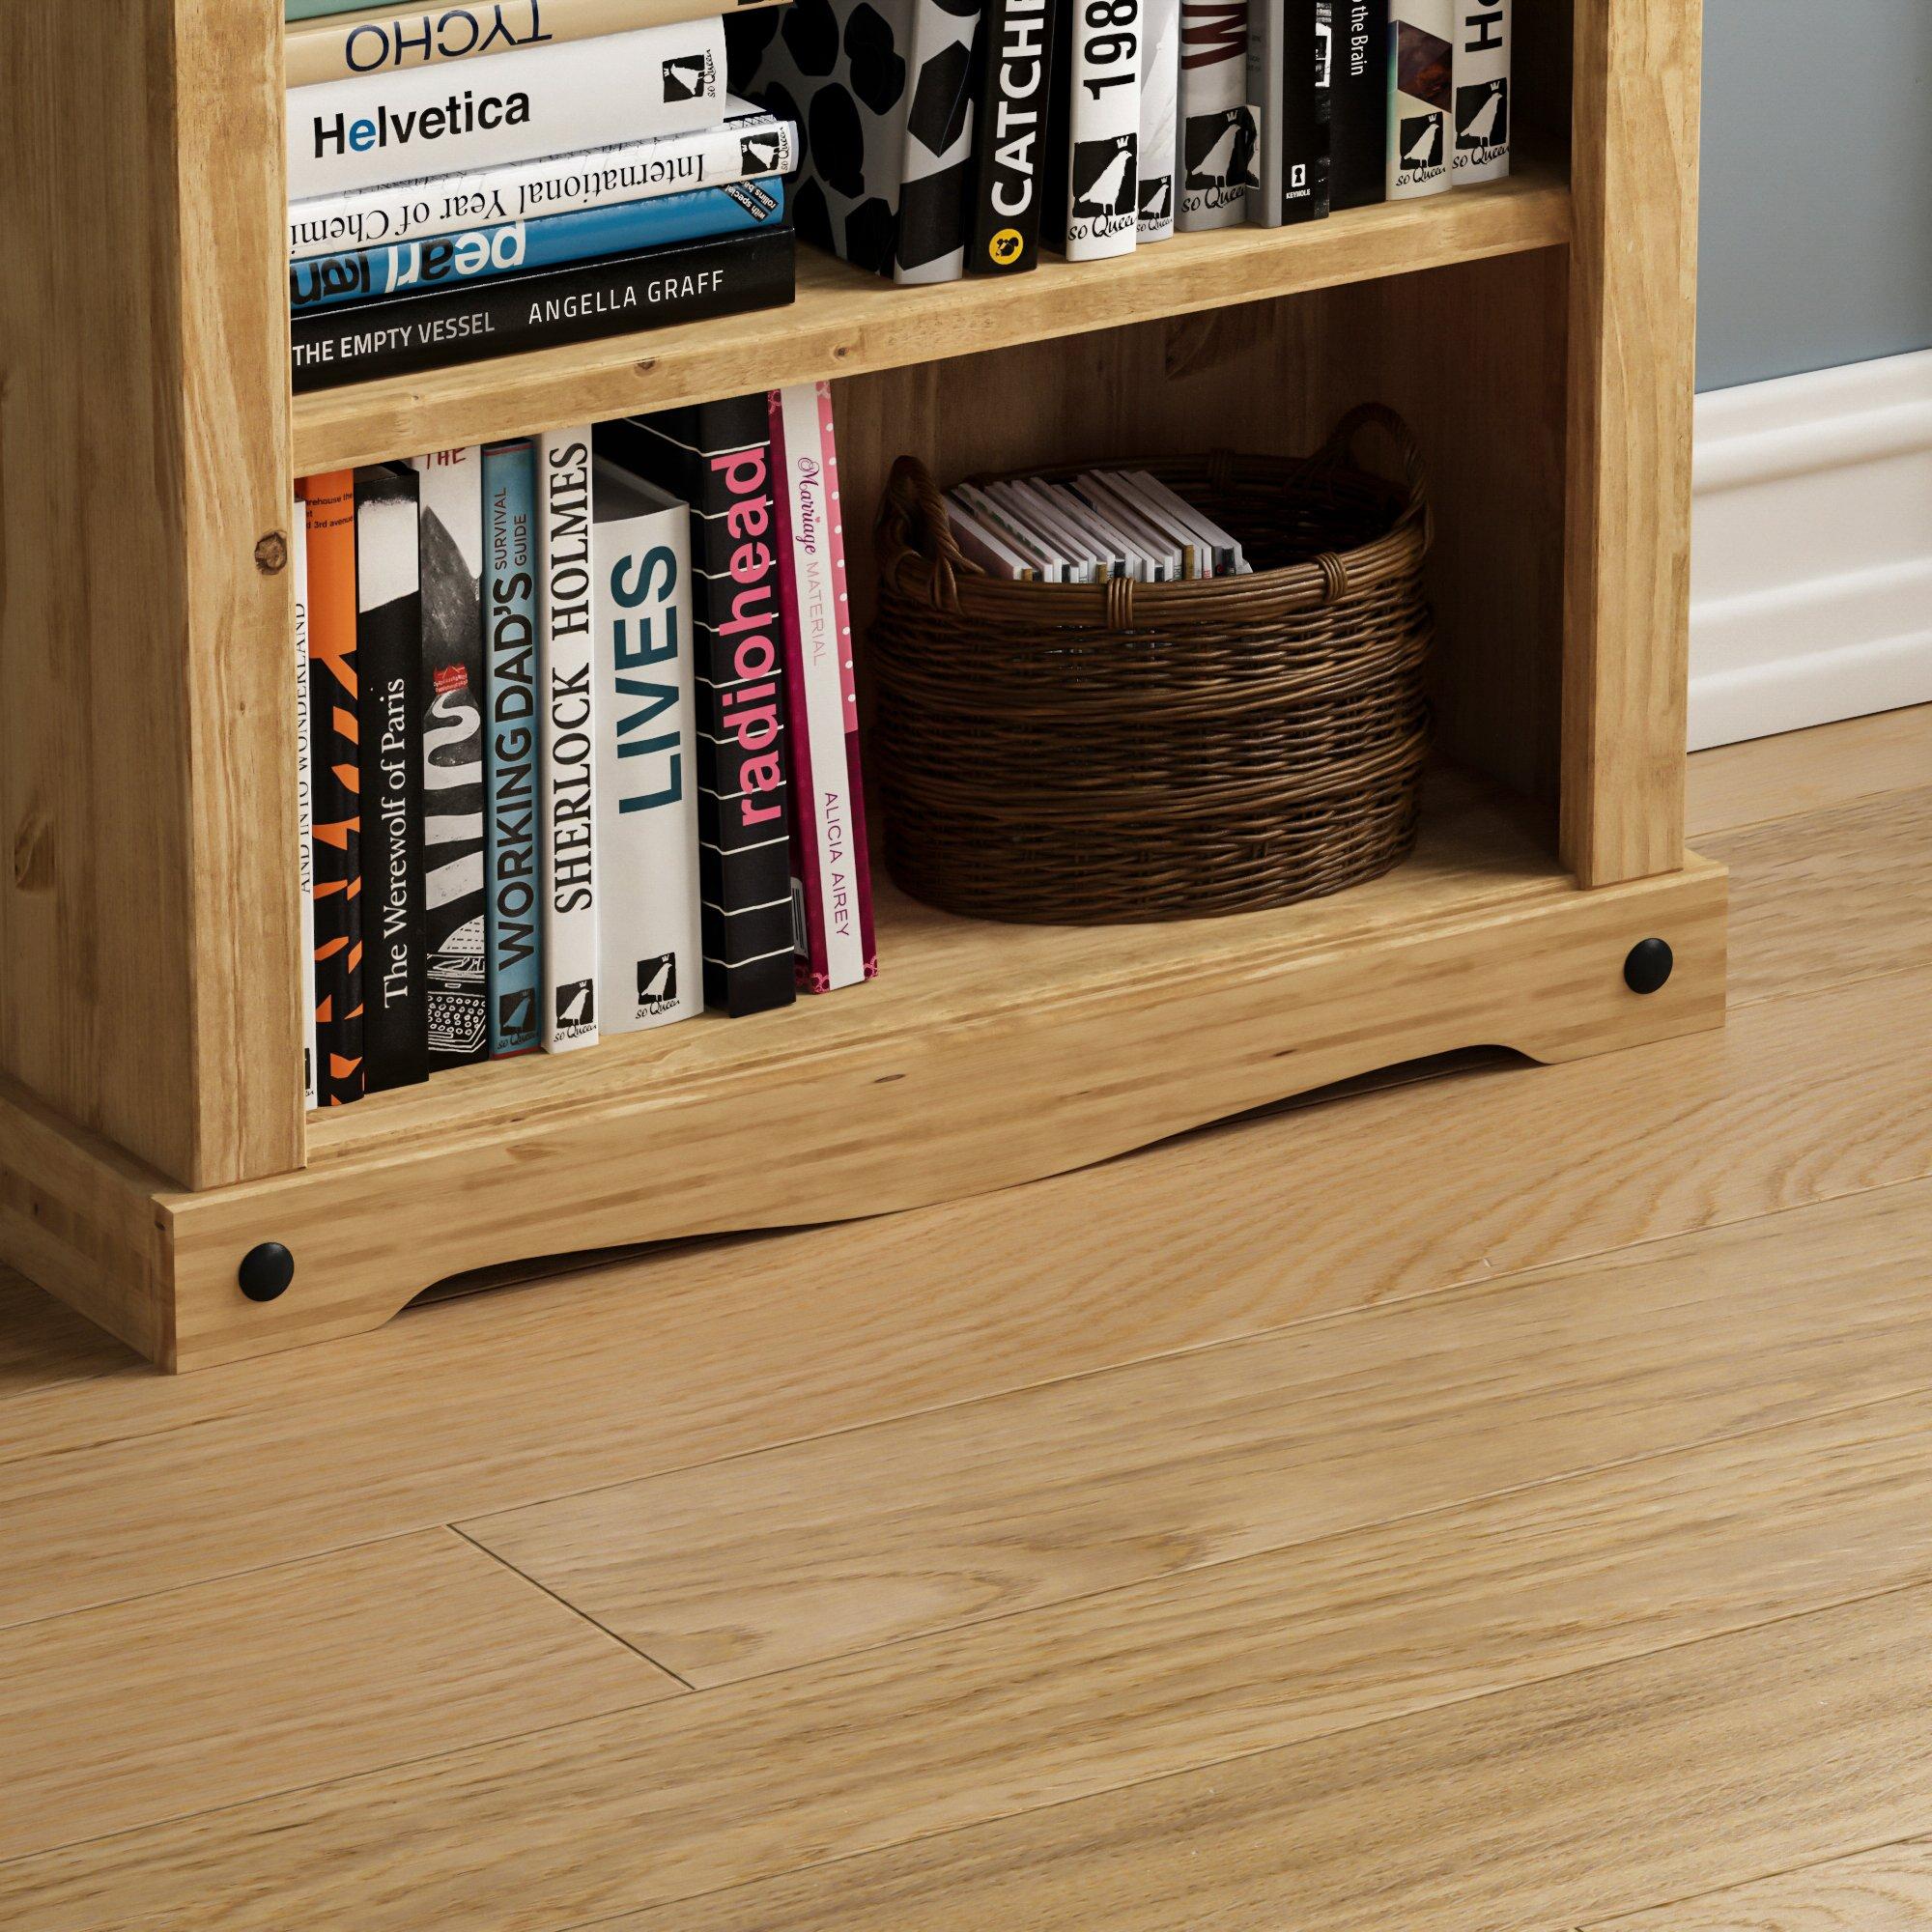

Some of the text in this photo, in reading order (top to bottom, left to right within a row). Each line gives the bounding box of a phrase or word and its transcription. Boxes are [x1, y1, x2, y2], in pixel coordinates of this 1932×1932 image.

[346, 0, 553, 71] TYCHO
[1351, 6, 1369, 75] the Brain
[702, 49, 716, 84] Queen
[314, 91, 530, 158] Helvetica
[519, 154, 704, 213] International
[1396, 175, 1409, 186] so
[1452, 156, 1467, 169] so
[394, 202, 430, 236] of
[440, 189, 507, 219] Year
[724, 185, 766, 219] with special
[754, 188, 777, 209] rollins
[1181, 196, 1201, 213] so
[1286, 188, 1311, 199] KEYHOLE
[384, 220, 526, 294] pearl
[1067, 224, 1088, 242] so
[528, 270, 724, 325] ANGELLA GRAFF
[292, 312, 496, 366] THE EMPTY VESSEL
[494, 487, 507, 571] SURVIVAL
[514, 513, 527, 567] GUIDE
[795, 457, 827, 667] Marriage MATERIAL
[710, 447, 781, 827] radiohead
[549, 442, 593, 914] SHERLOCK HOLMES
[611, 545, 683, 814] LIVES
[493, 572, 535, 972] WORKING DAD'S
[380, 678, 409, 1009] The Werewolf of Paris
[825, 792, 850, 936] ALICIA AIREY
